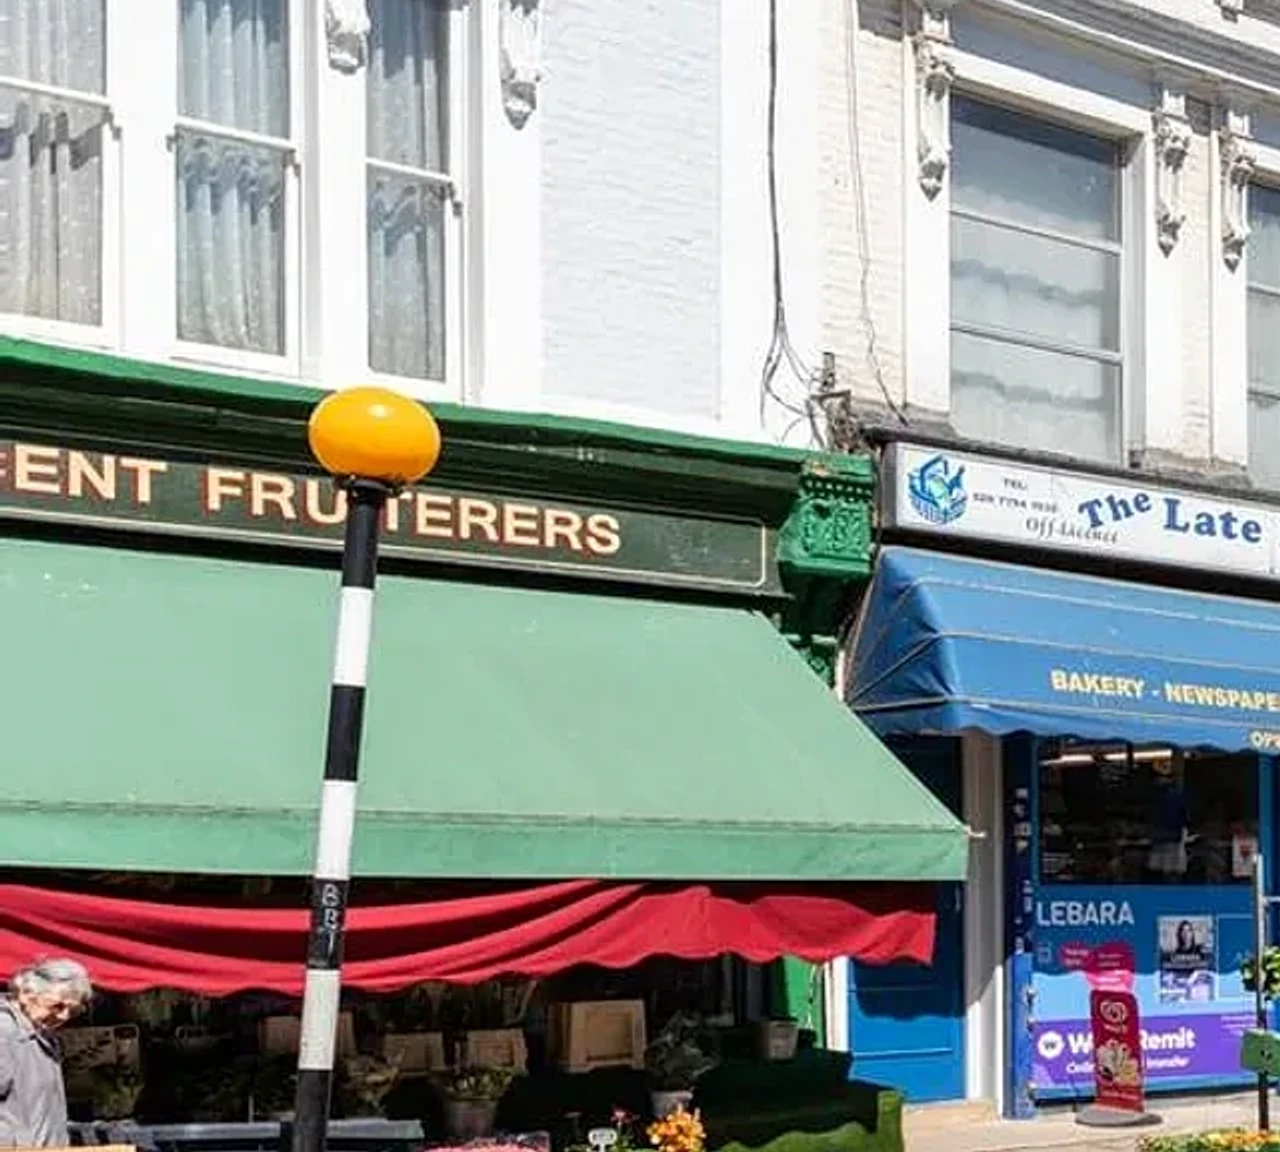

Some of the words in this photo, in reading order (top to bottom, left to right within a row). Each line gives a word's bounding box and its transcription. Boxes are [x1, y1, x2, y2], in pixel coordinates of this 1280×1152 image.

[0, 444, 167, 503] ENT
[207, 468, 620, 554] FRUTERERS
[1078, 492, 1151, 529] The
[1163, 498, 1262, 543] Late
[1051, 669, 1145, 700] BAKERY
[1036, 901, 1135, 926] LEBARA
[1068, 1027, 1196, 1055] WRemit
